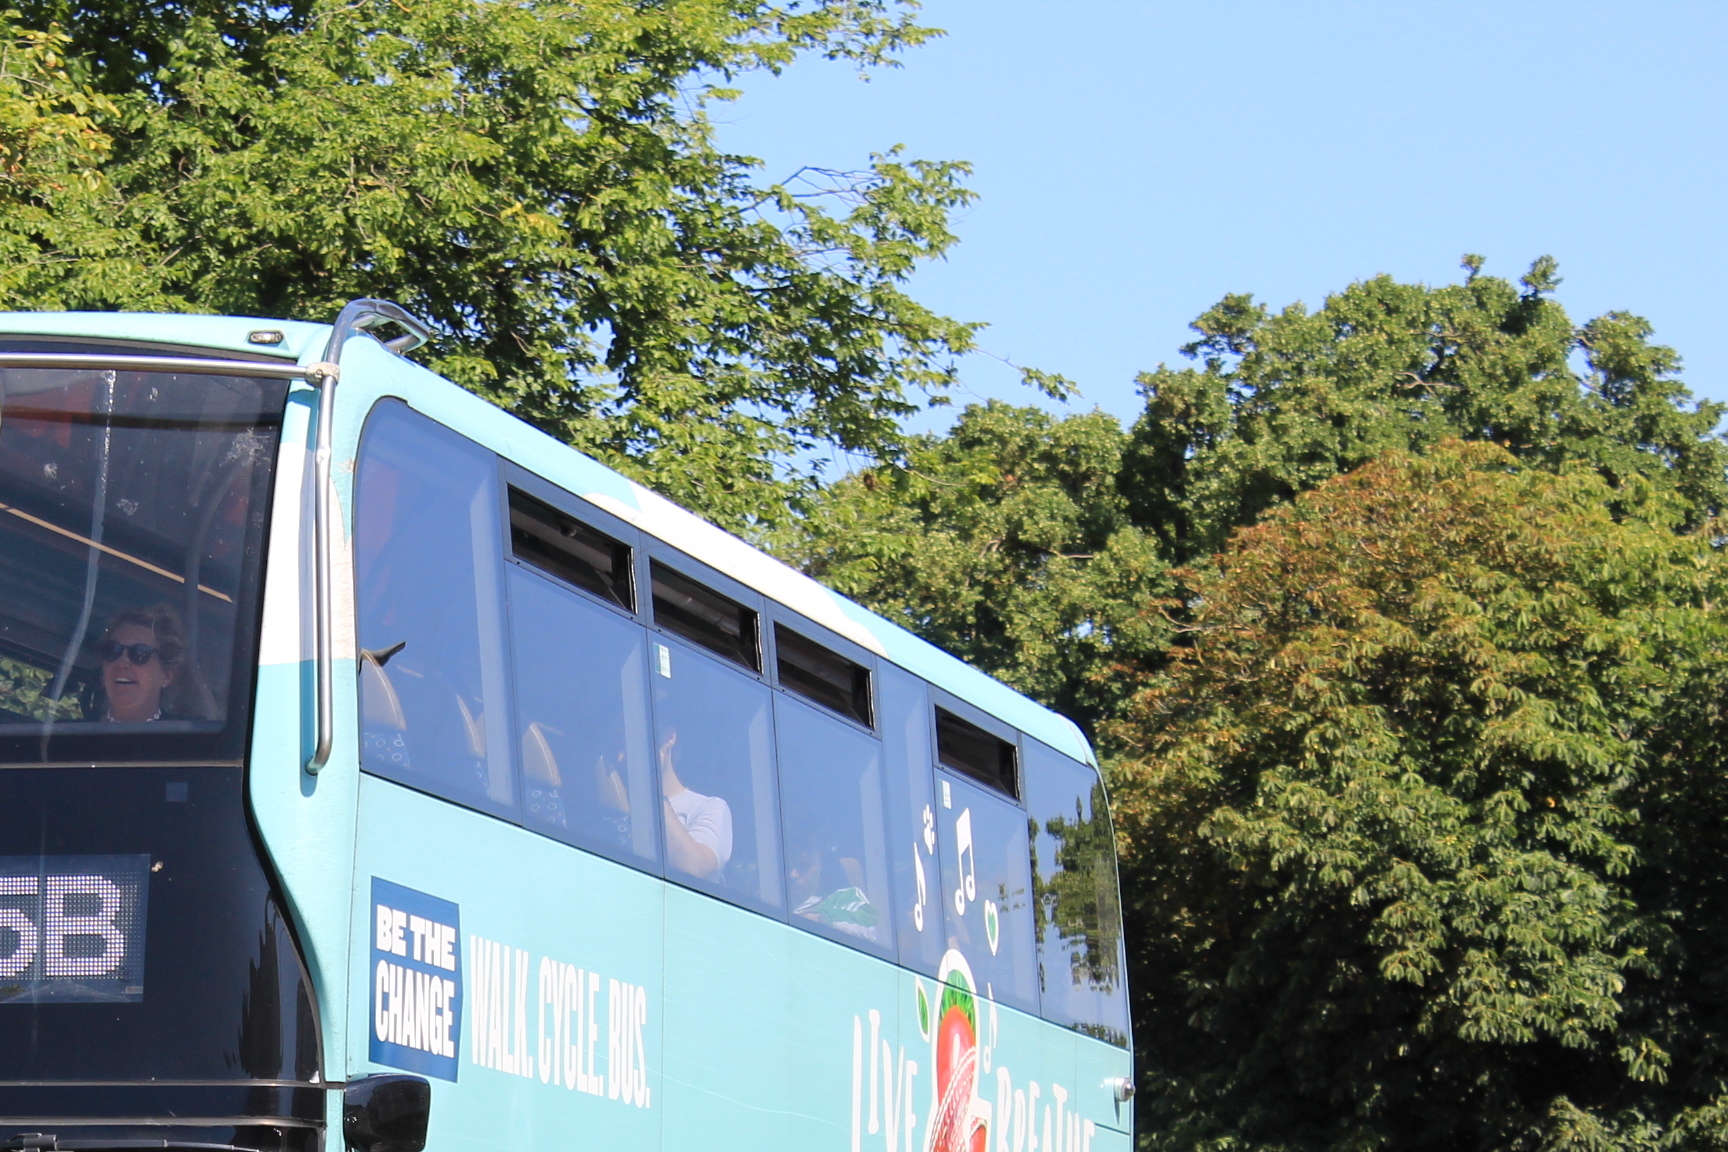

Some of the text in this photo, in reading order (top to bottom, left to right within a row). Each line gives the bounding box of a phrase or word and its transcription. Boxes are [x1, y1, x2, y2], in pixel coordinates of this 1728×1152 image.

[376, 904, 456, 972] BE THE
[375, 959, 455, 1058] CHANGE
[470, 934, 651, 1109] WALK. CYCLE. BUS.
